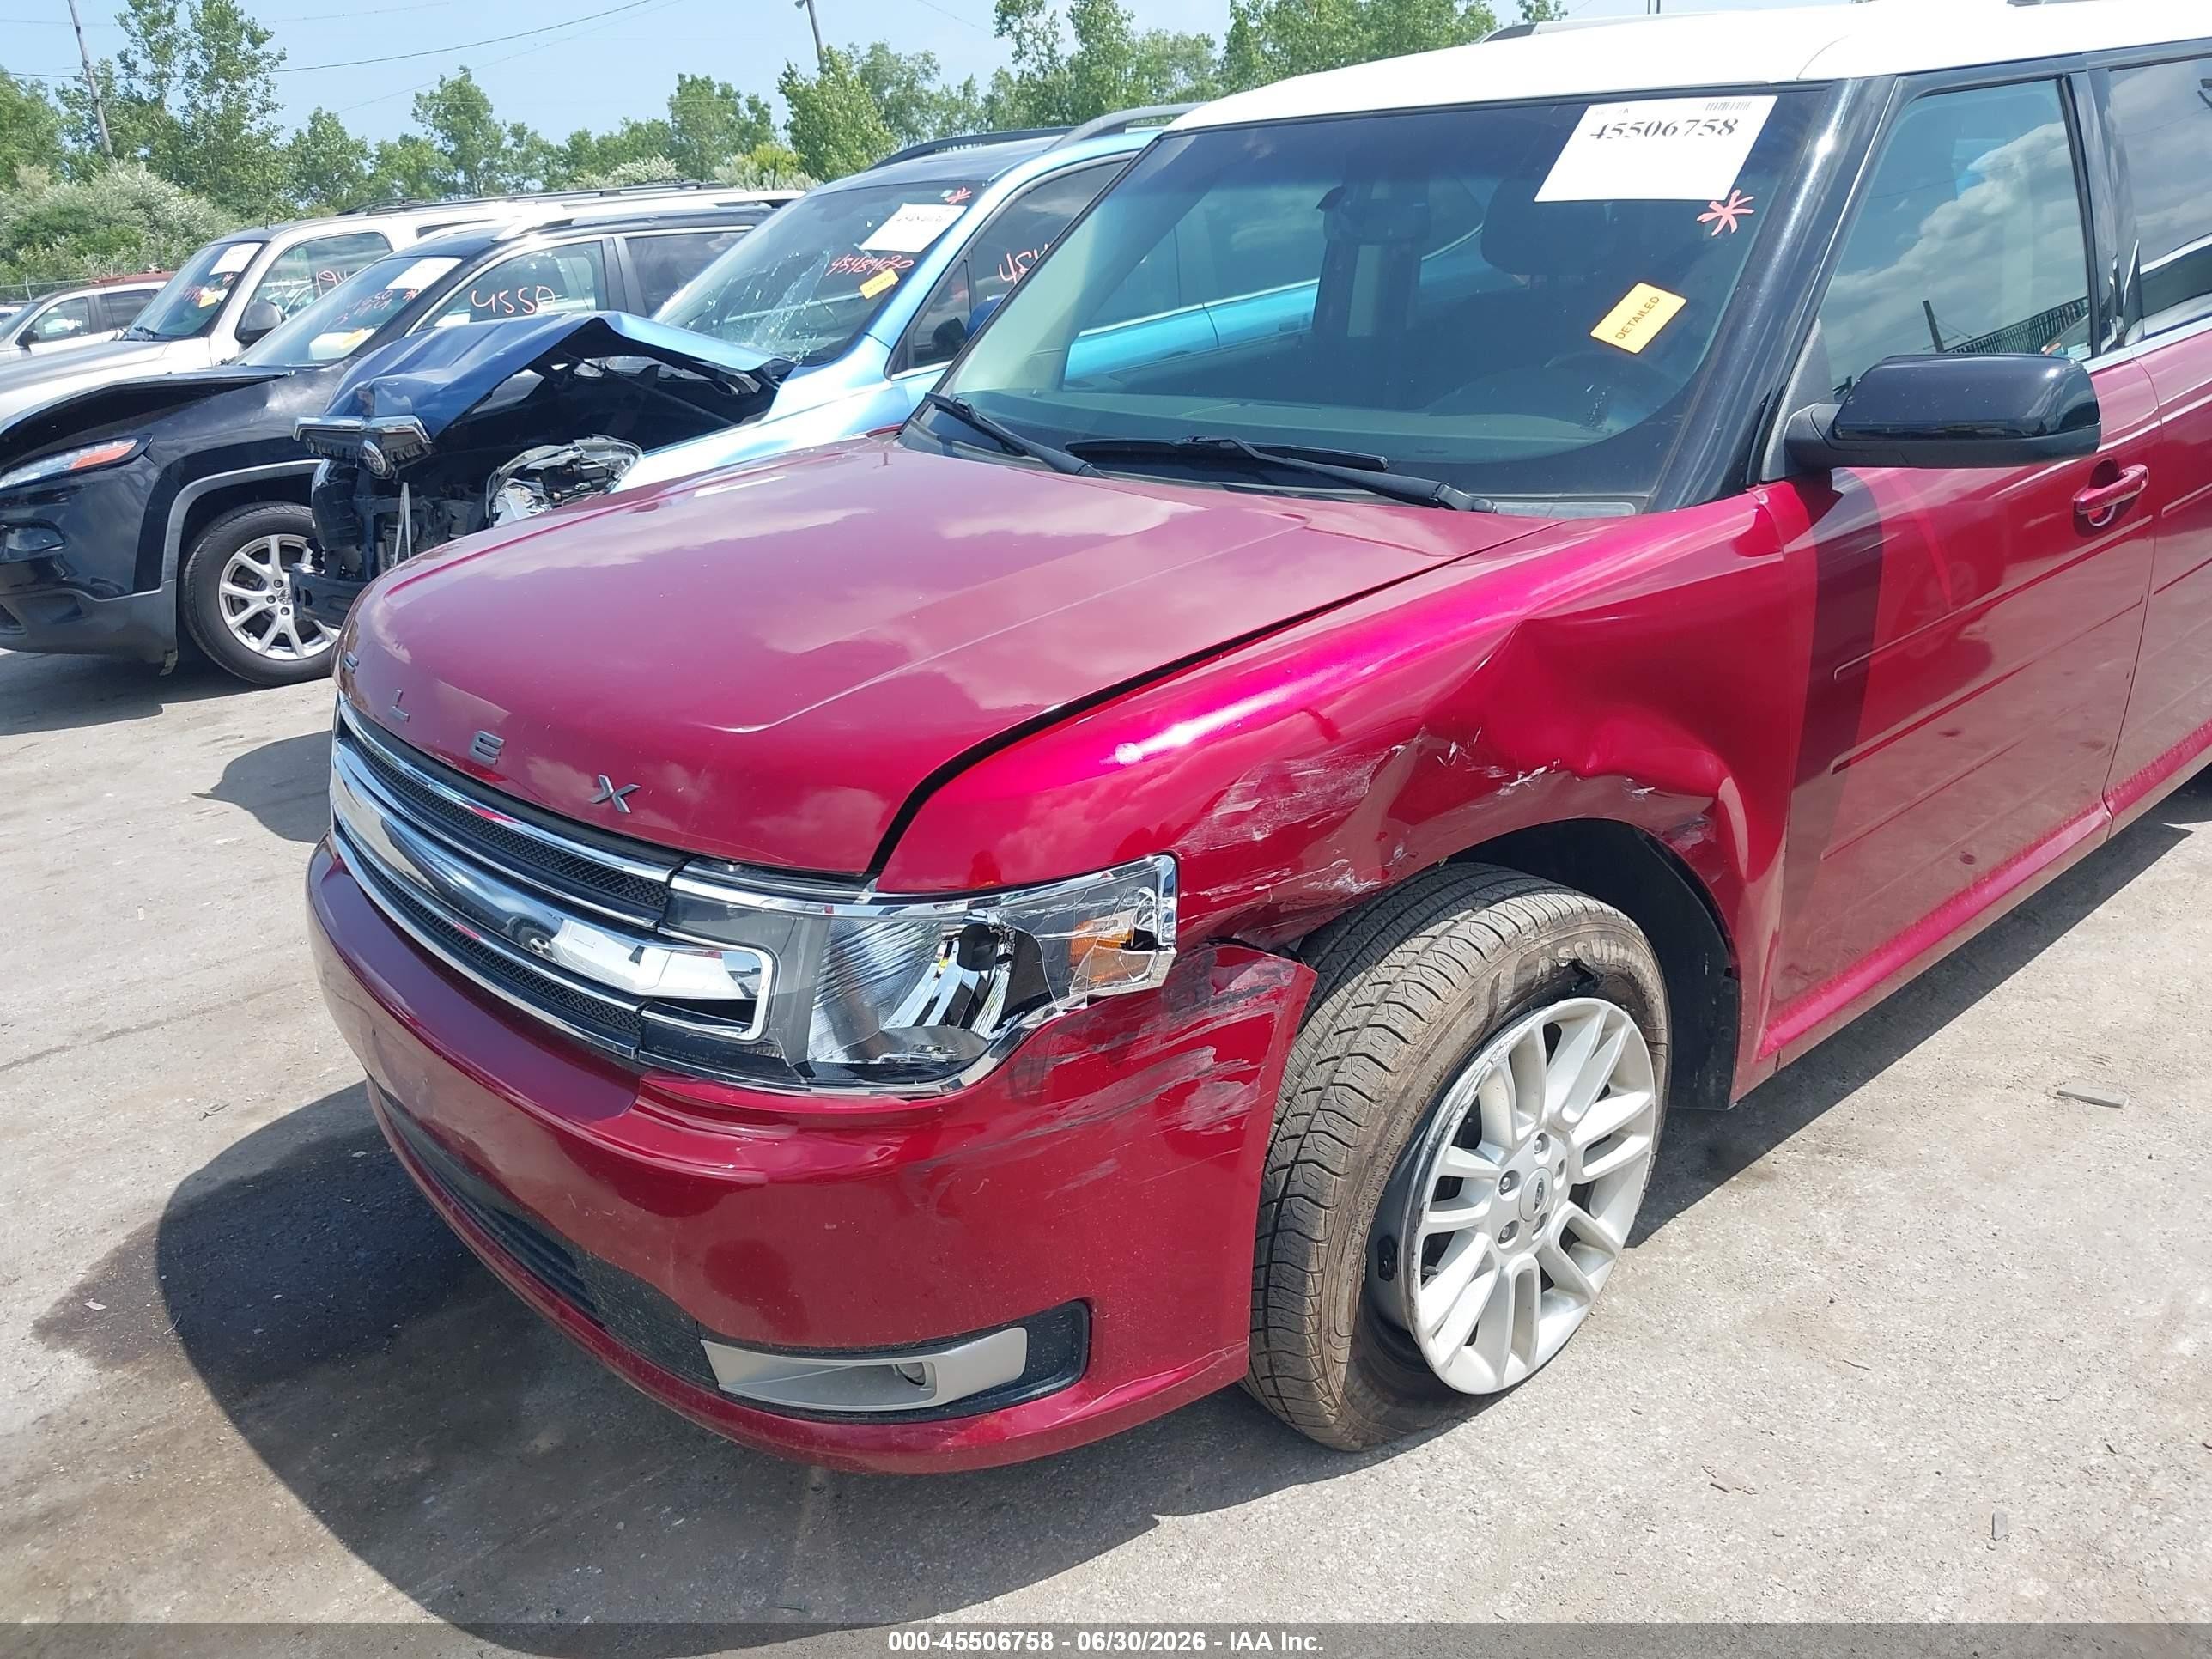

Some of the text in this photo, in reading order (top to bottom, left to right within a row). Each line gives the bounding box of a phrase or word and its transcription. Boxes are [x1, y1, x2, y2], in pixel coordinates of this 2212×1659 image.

[1589, 118, 1740, 140] 45506758
[471, 284, 556, 314] 4550
[1614, 295, 1661, 340] DETAILED
